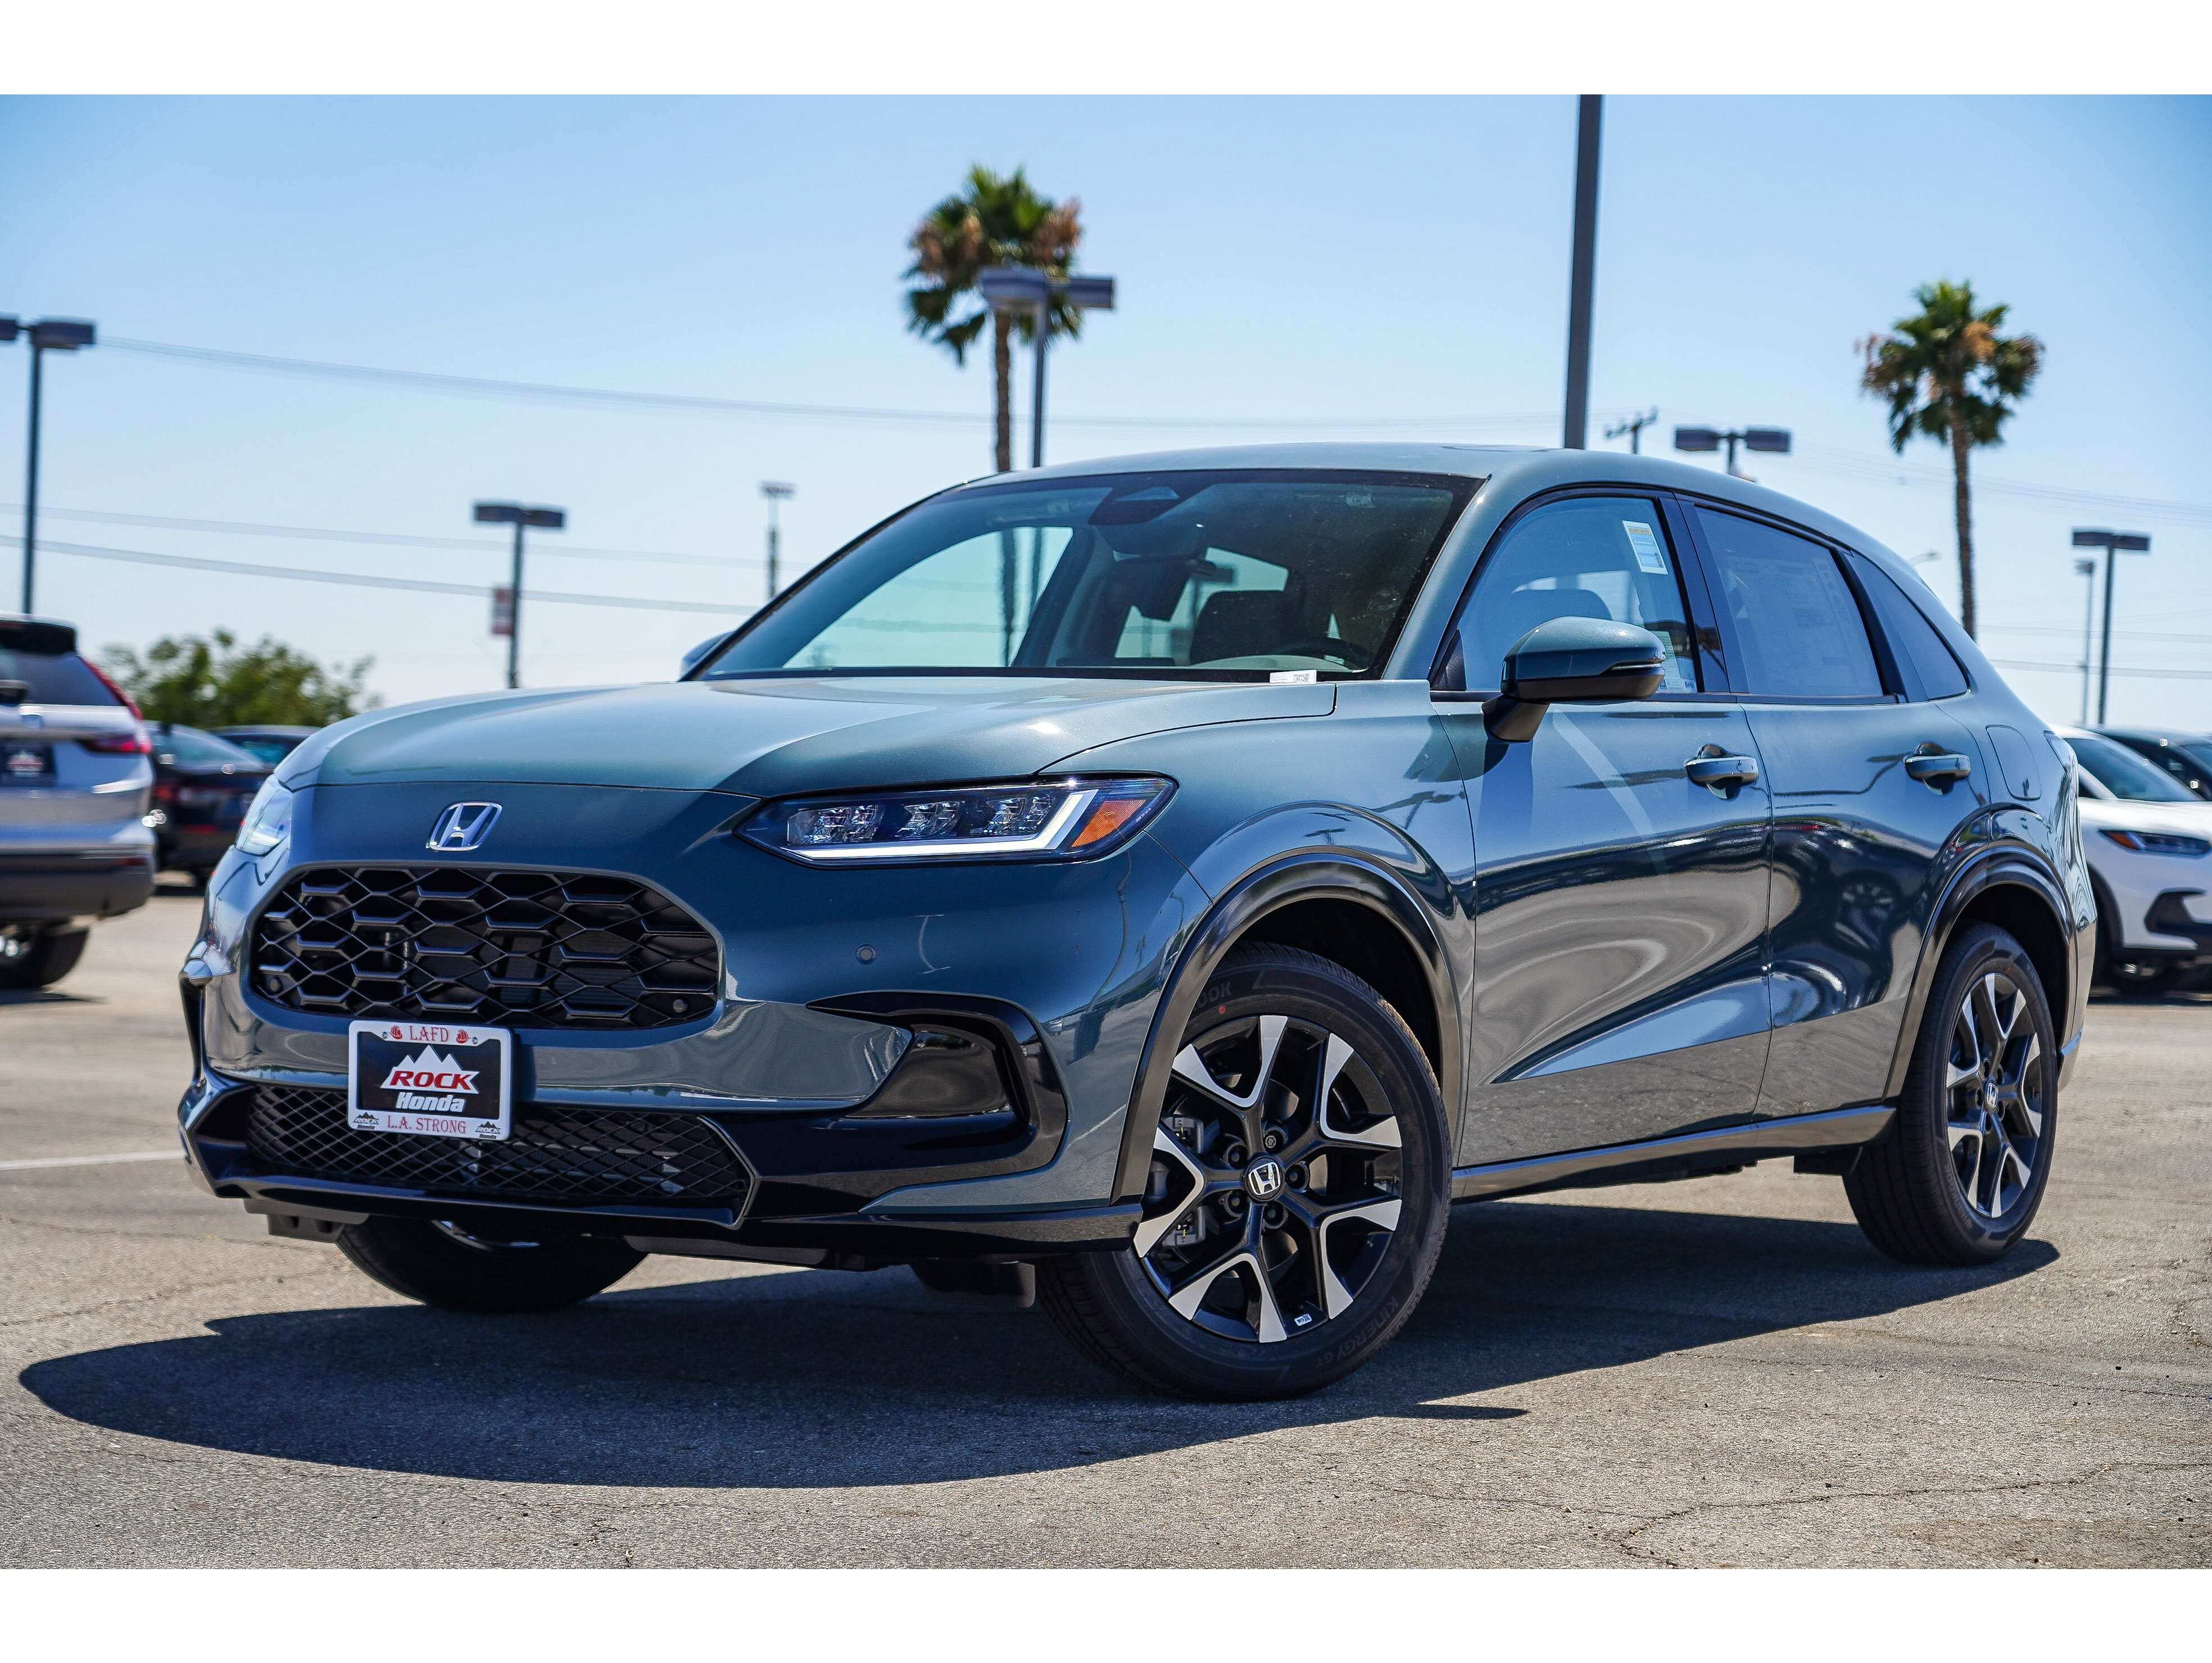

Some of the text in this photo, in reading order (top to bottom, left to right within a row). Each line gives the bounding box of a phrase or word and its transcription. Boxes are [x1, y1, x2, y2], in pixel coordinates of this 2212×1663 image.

[410, 1025, 450, 1043] LAFD
[389, 1070, 472, 1090] ROCK
[395, 1091, 466, 1113] Honda
[387, 1115, 467, 1134] L.A. STRONG
